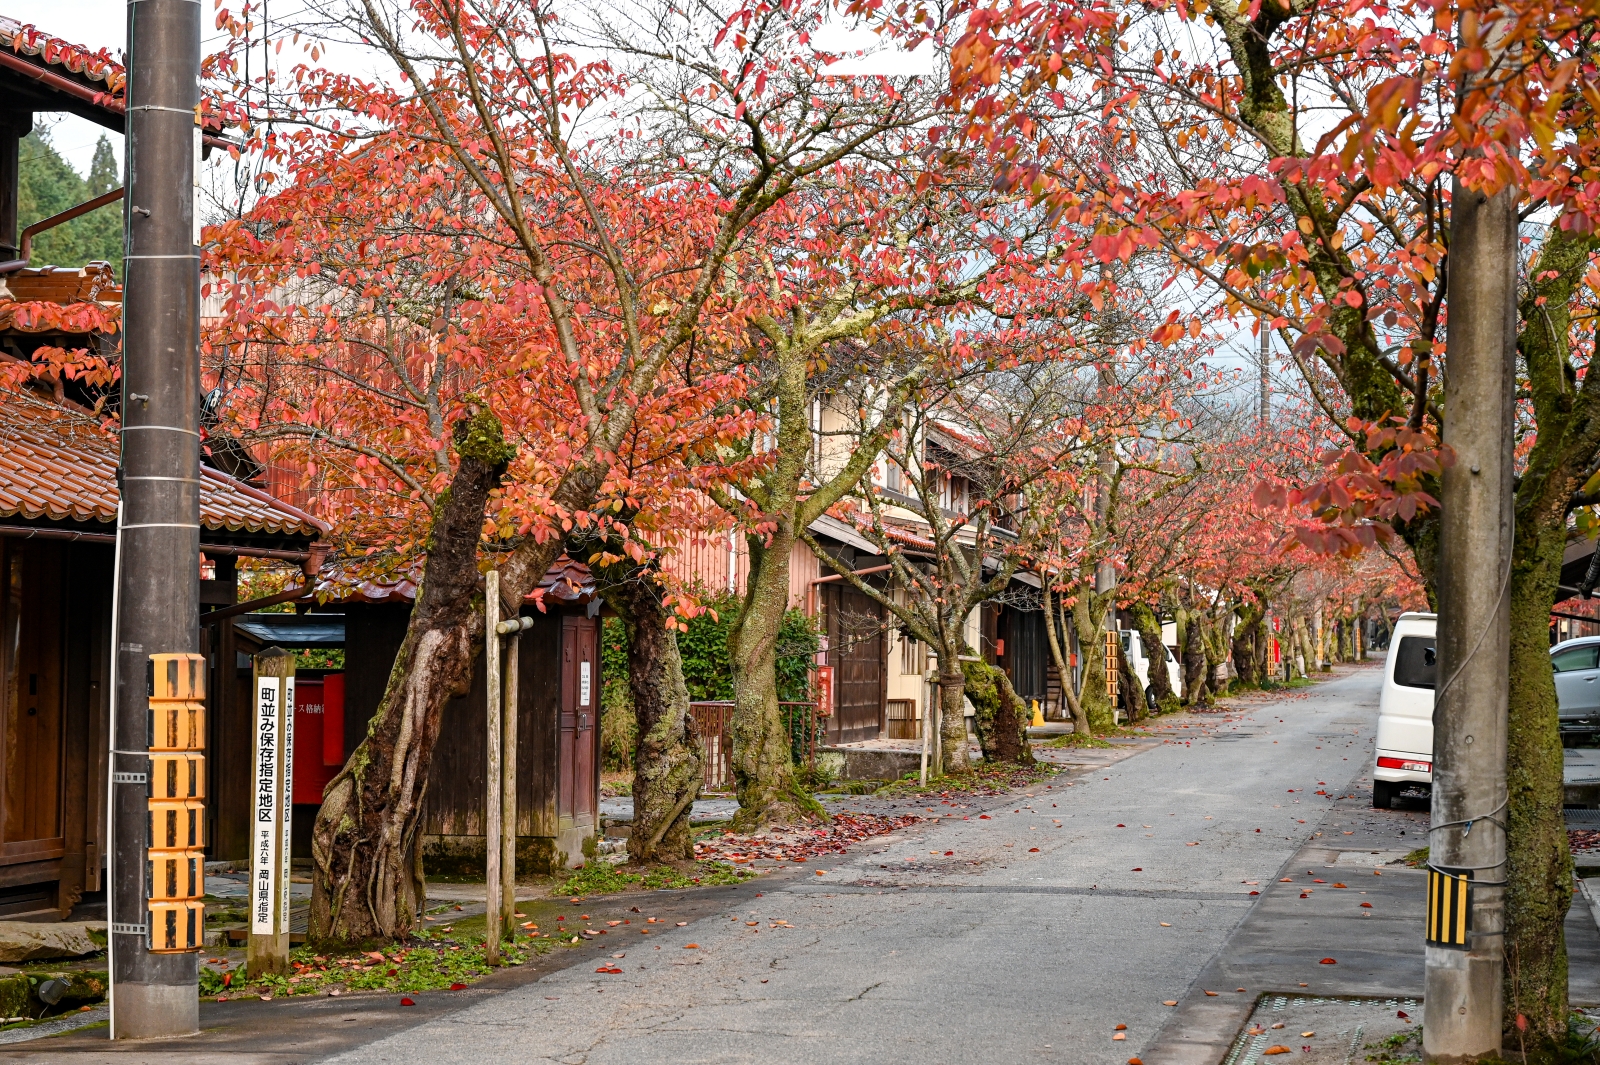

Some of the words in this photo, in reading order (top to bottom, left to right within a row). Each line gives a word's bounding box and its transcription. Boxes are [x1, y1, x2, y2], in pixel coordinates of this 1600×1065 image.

[258, 687, 275, 822] 町並み保存指定地区
[260, 830, 270, 865] 平成六年
[257, 869, 269, 924] 岡山県指定
